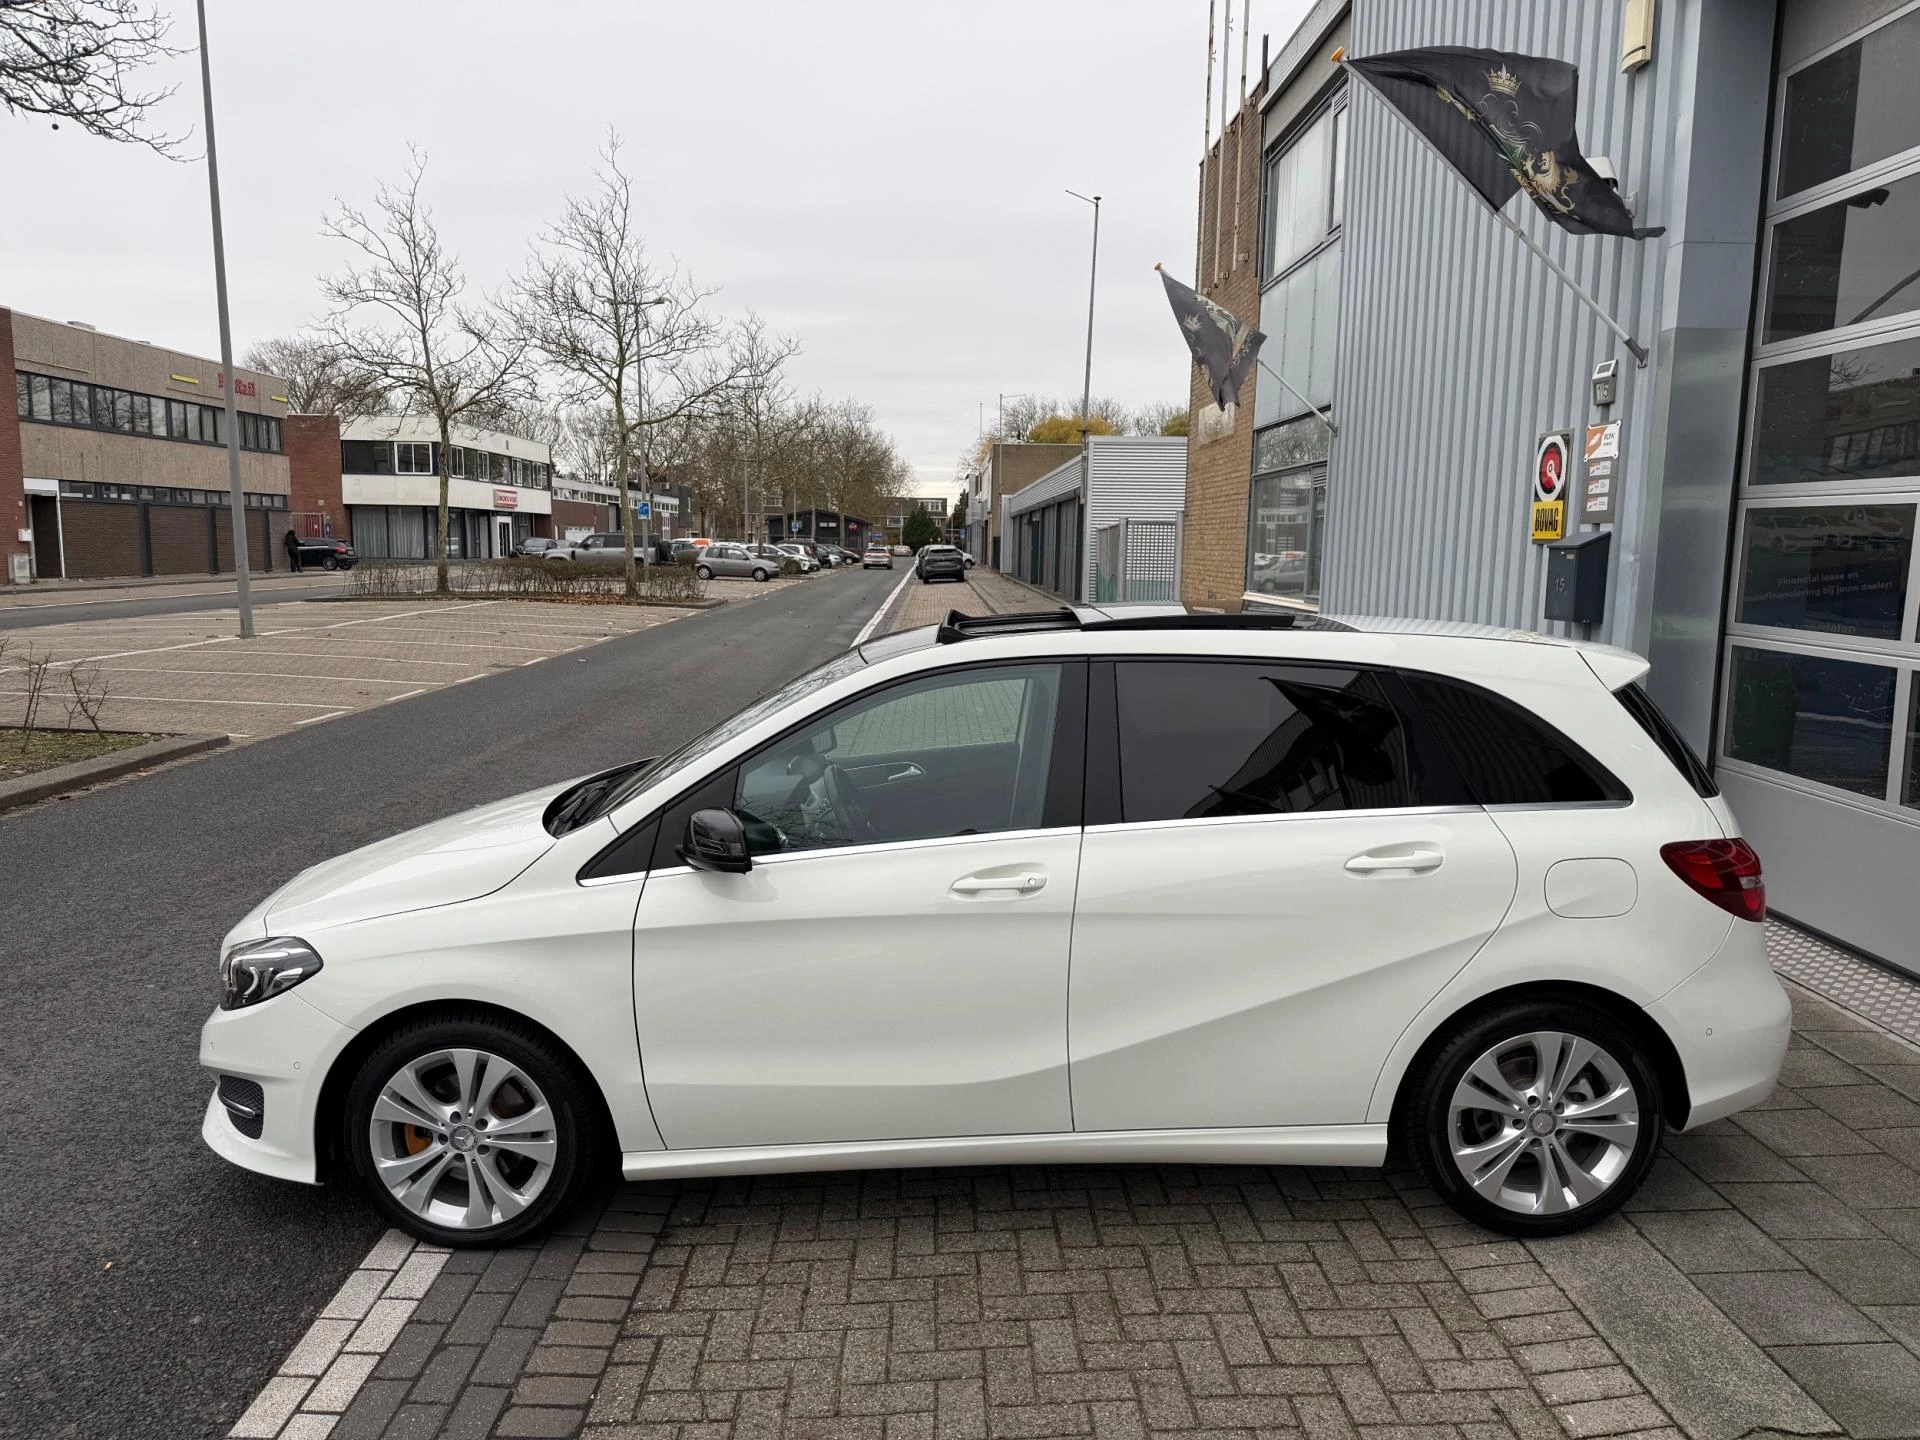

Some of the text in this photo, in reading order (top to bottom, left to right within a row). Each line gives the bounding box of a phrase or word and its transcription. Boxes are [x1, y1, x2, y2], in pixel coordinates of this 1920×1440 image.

[1596, 382, 1609, 400] 15
[1535, 508, 1559, 532] BOVAG
[1555, 577, 1565, 592] 15
